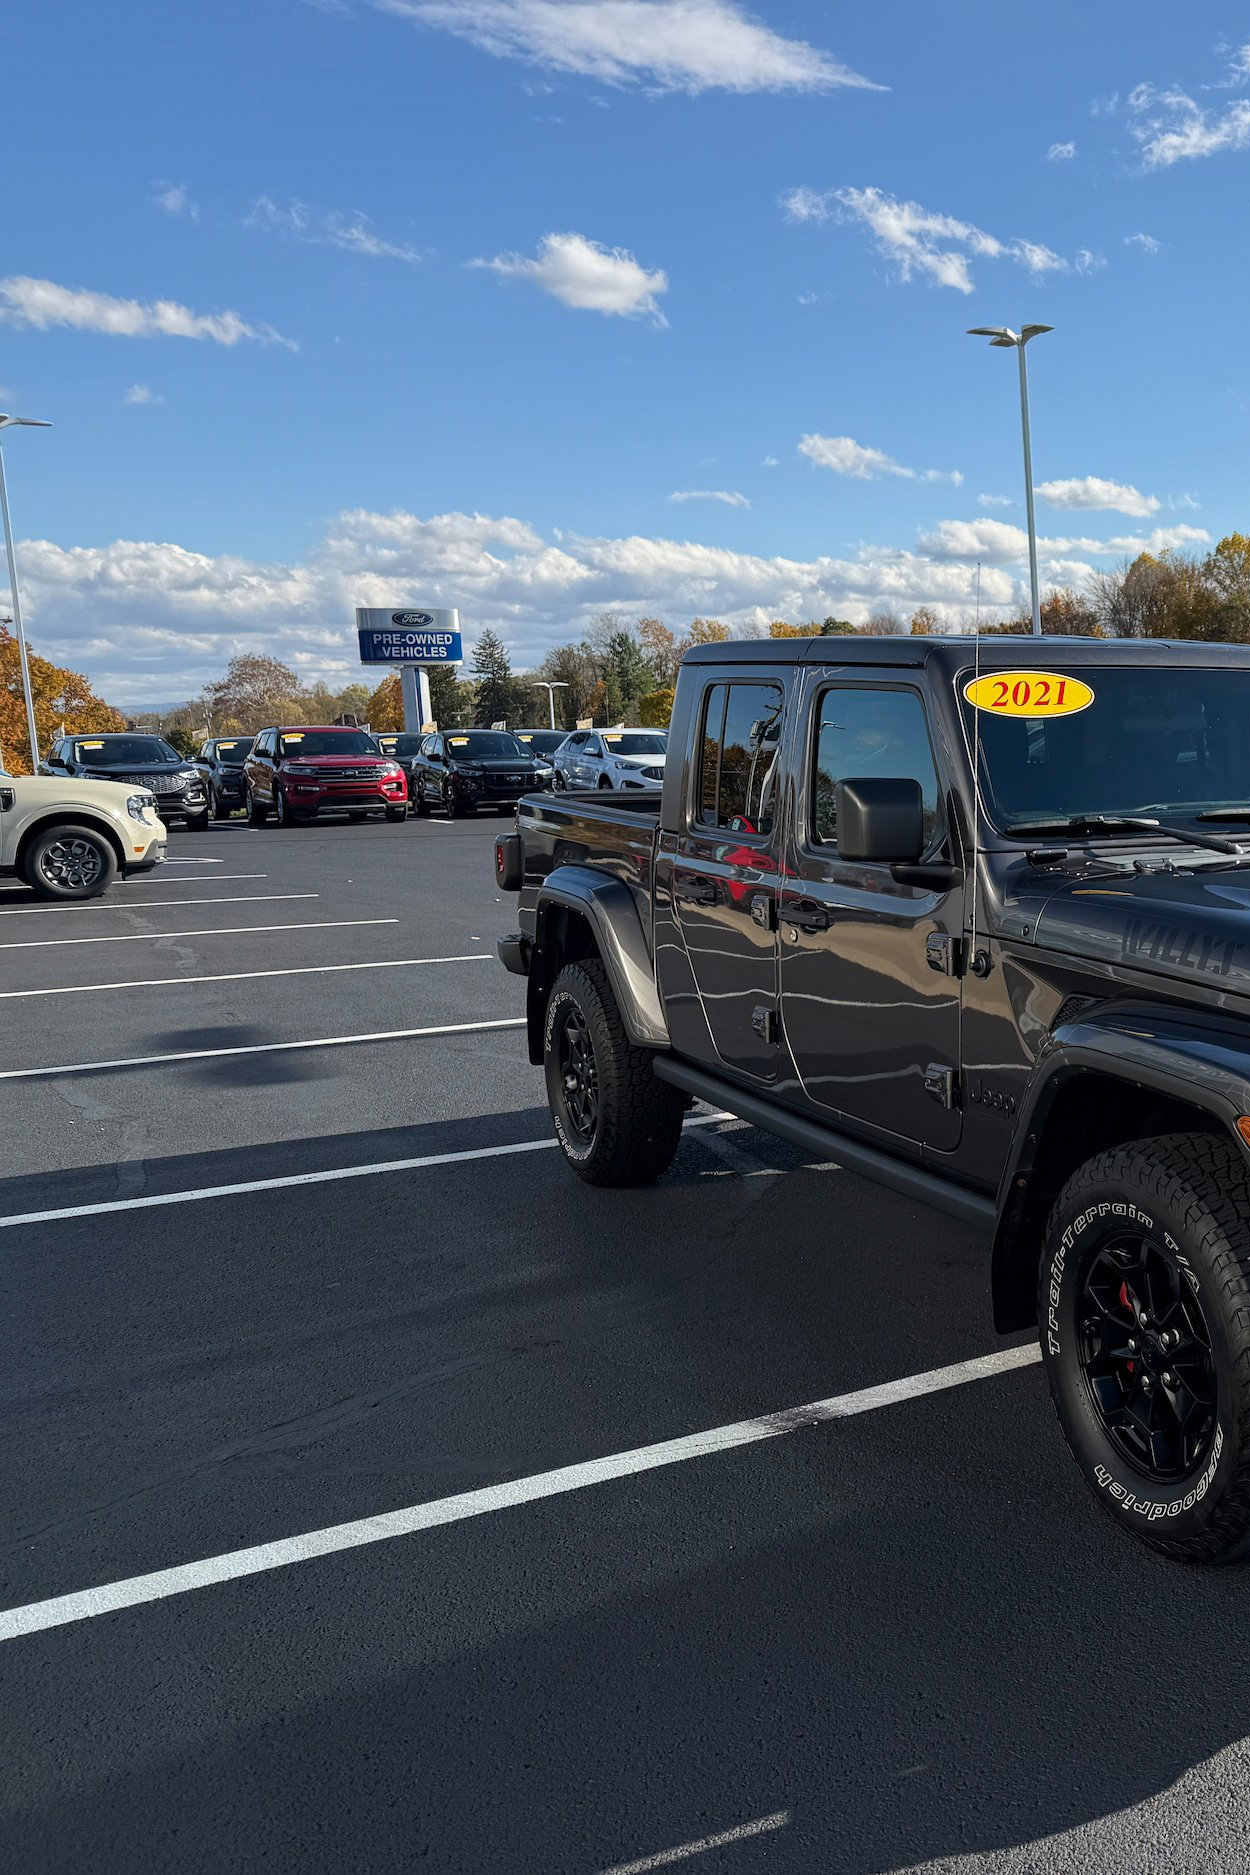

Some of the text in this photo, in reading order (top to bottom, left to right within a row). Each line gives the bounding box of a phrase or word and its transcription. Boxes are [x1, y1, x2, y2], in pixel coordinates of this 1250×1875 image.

[373, 633, 453, 644] PRE-OWNED
[382, 646, 447, 657] VEHICLES
[991, 680, 1067, 707] 2021
[1121, 918, 1246, 977] WILLYS
[969, 1080, 1016, 1119] Jeep
[1047, 1202, 1154, 1356] Trail-Terrain
